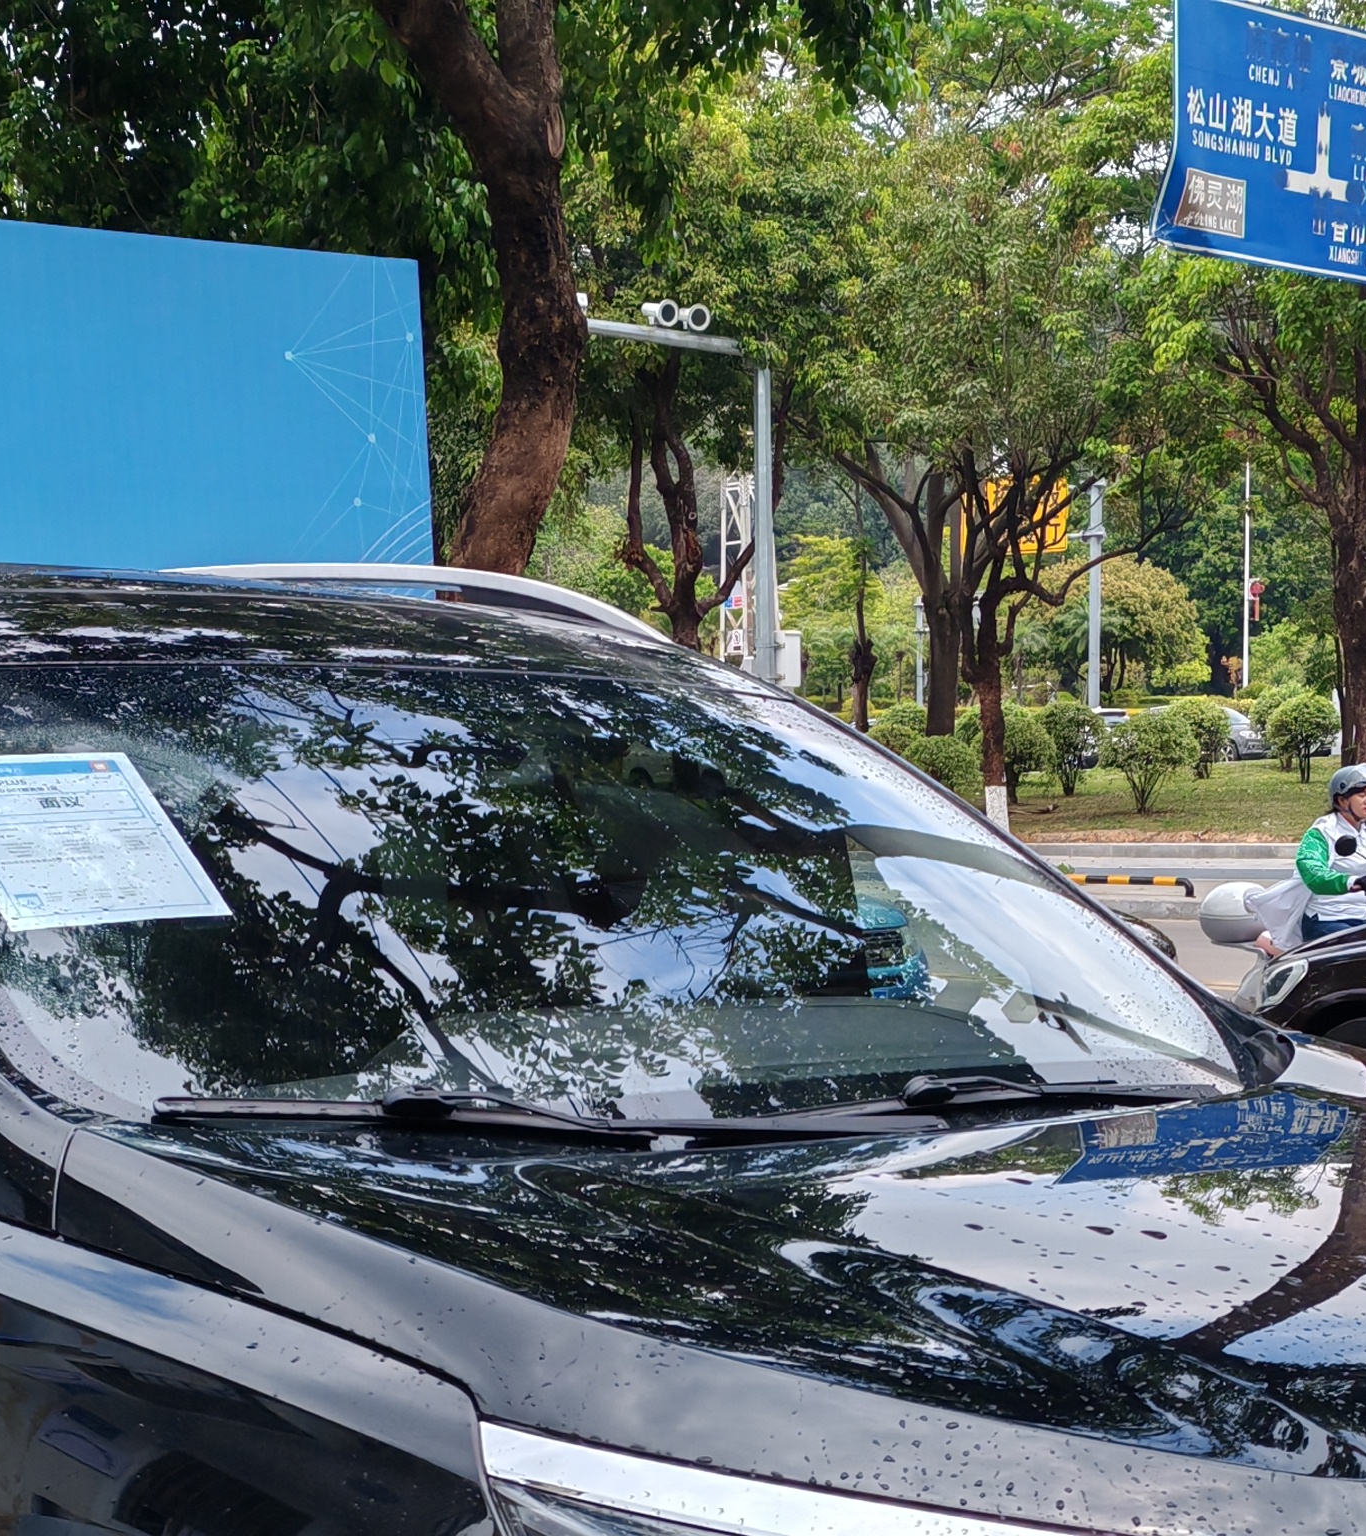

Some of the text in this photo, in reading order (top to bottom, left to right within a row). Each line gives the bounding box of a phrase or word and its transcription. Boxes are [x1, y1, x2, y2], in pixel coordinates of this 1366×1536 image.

[1187, 85, 1298, 147] 松山湖大道
[1192, 128, 1293, 166] SONGSHANHU BLVD
[1187, 174, 1243, 216] 佛灵湖
[1219, 216, 1237, 233] LAKE
